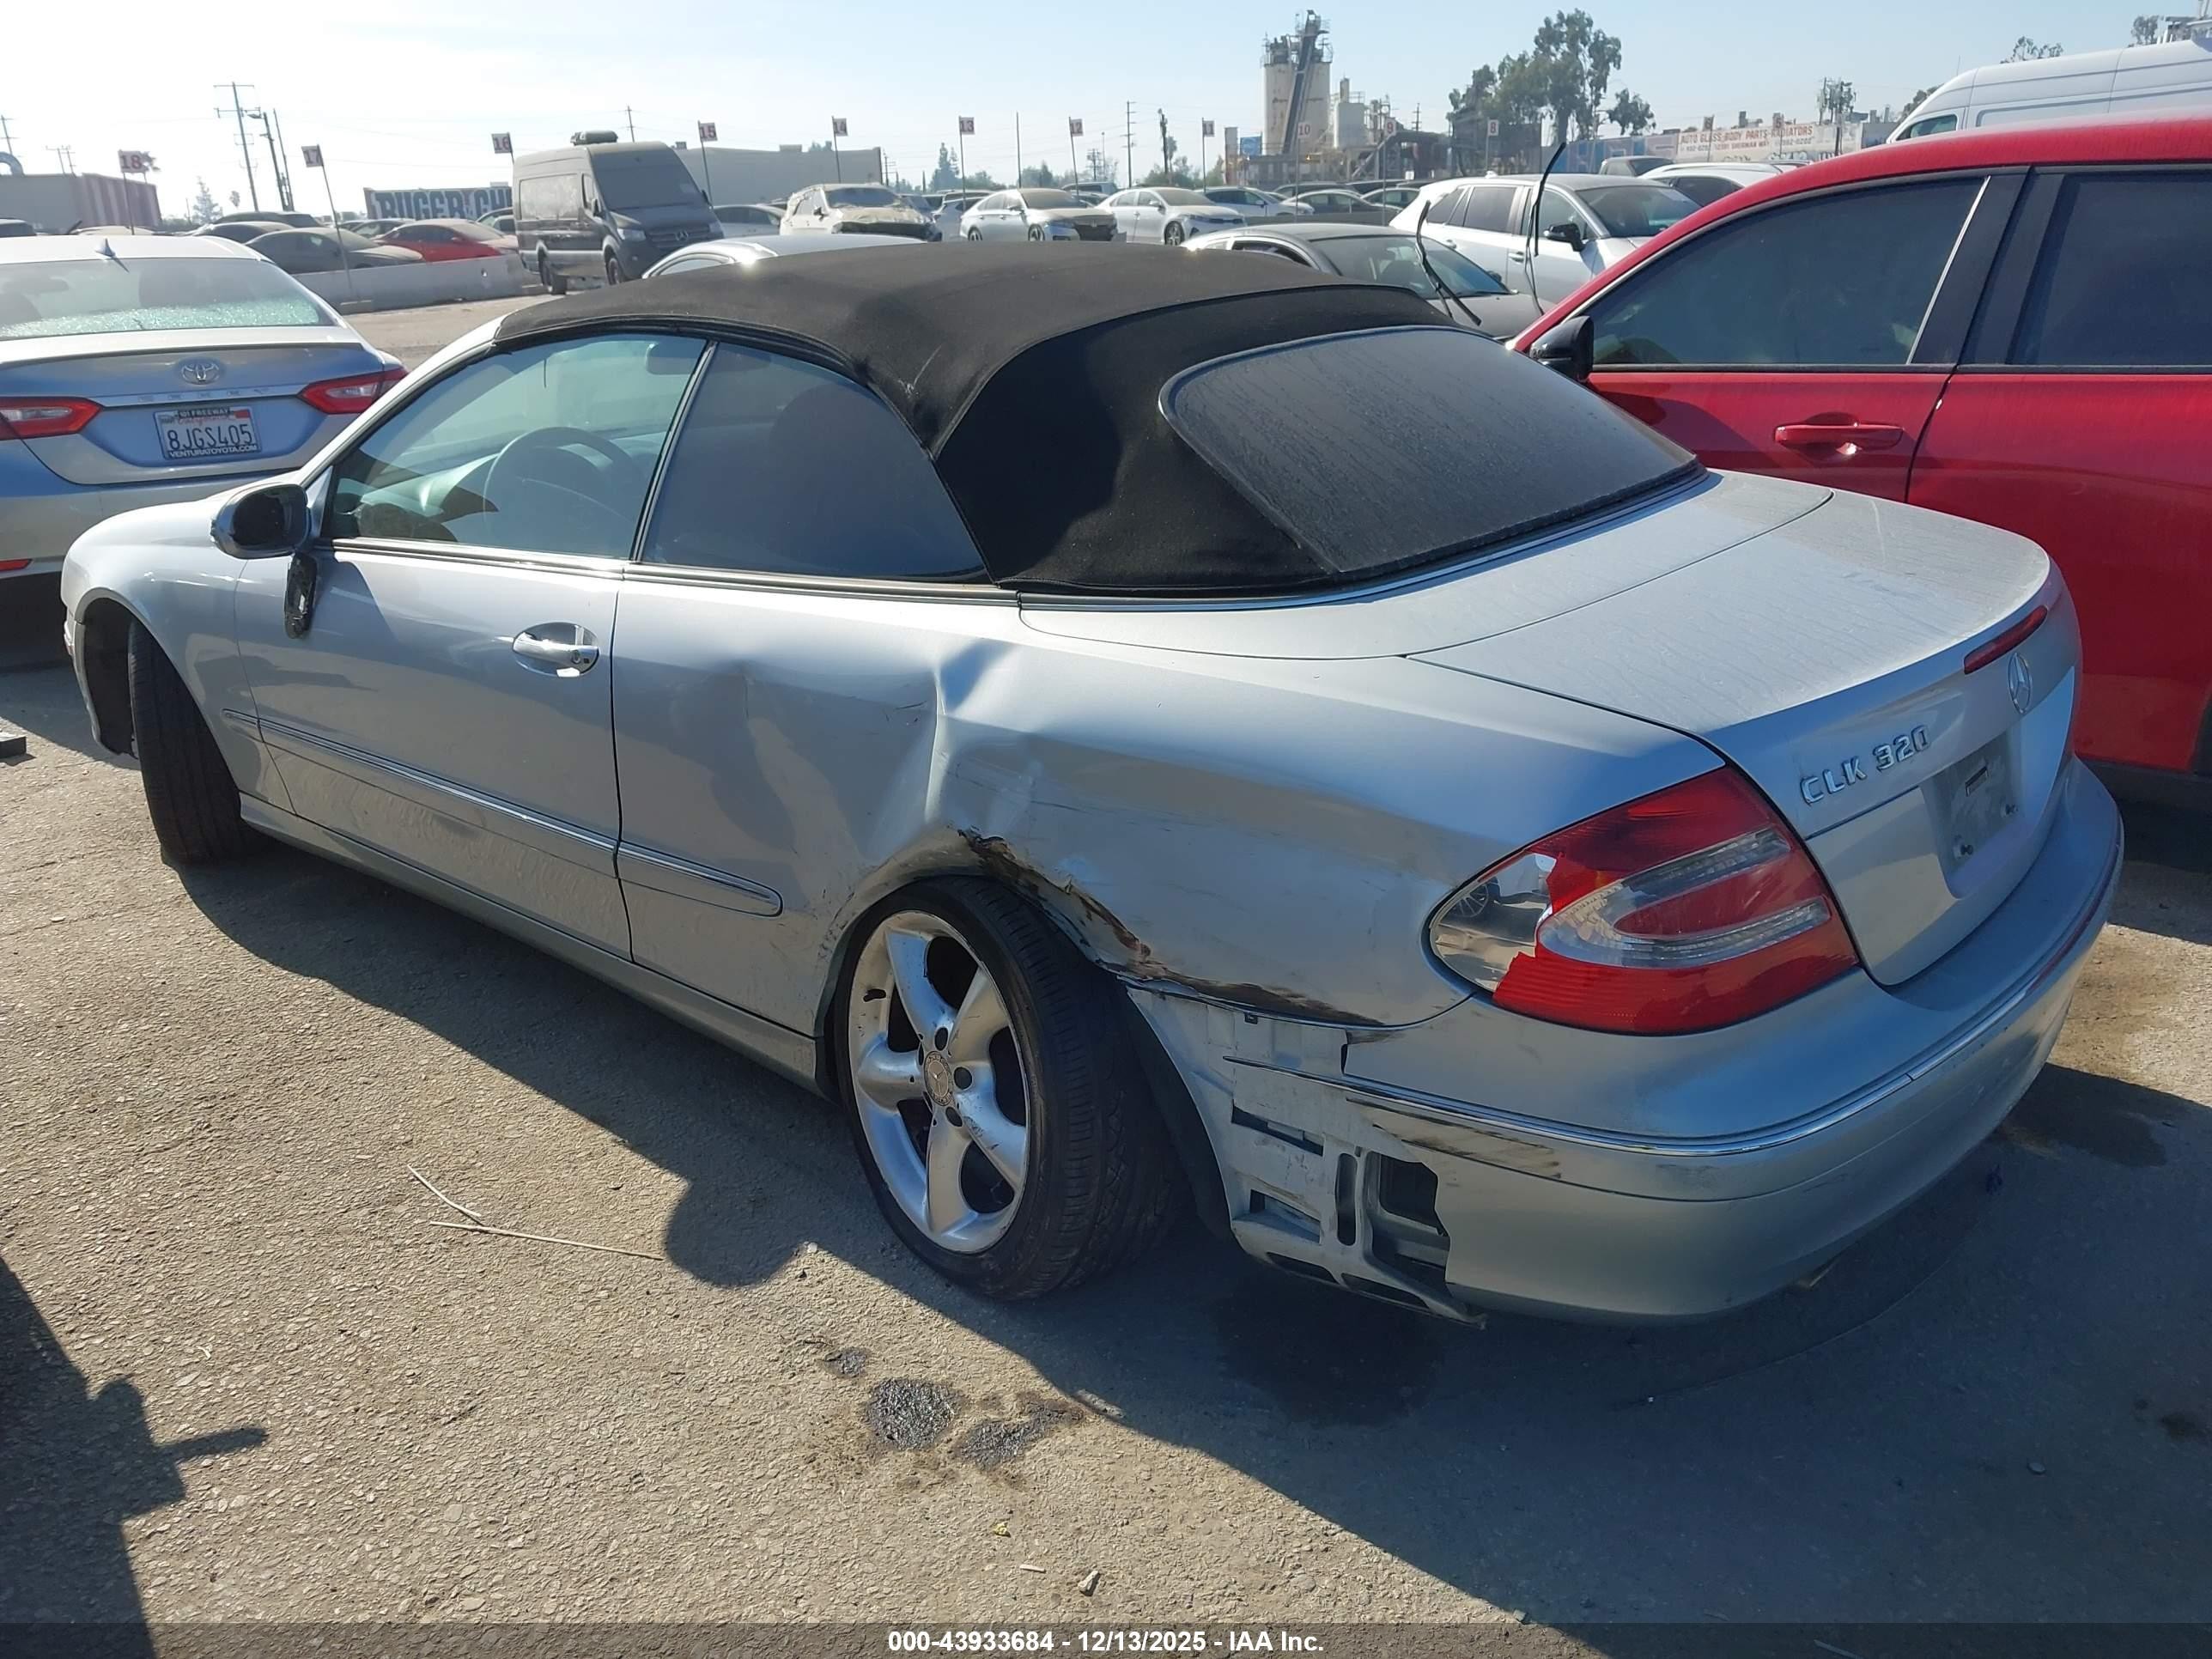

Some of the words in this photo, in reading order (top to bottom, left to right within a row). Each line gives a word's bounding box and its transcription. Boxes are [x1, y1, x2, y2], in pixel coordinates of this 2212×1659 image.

[834, 121, 847, 134] 14
[960, 119, 975, 132] 13
[1071, 121, 1082, 134] 12
[1298, 125, 1310, 136] 10
[1387, 123, 1394, 134] 9
[1490, 121, 1497, 133] 8
[700, 125, 716, 140] 15
[494, 137, 511, 151] 16
[1680, 135, 1698, 144] AUTO
[120, 155, 142, 169] 18
[304, 149, 322, 164] 17
[167, 424, 252, 451] 8JGS405
[169, 445, 258, 458] VENTURATOYOTA.COM
[1800, 756, 1867, 805] CLK
[1873, 725, 1930, 772] 320
